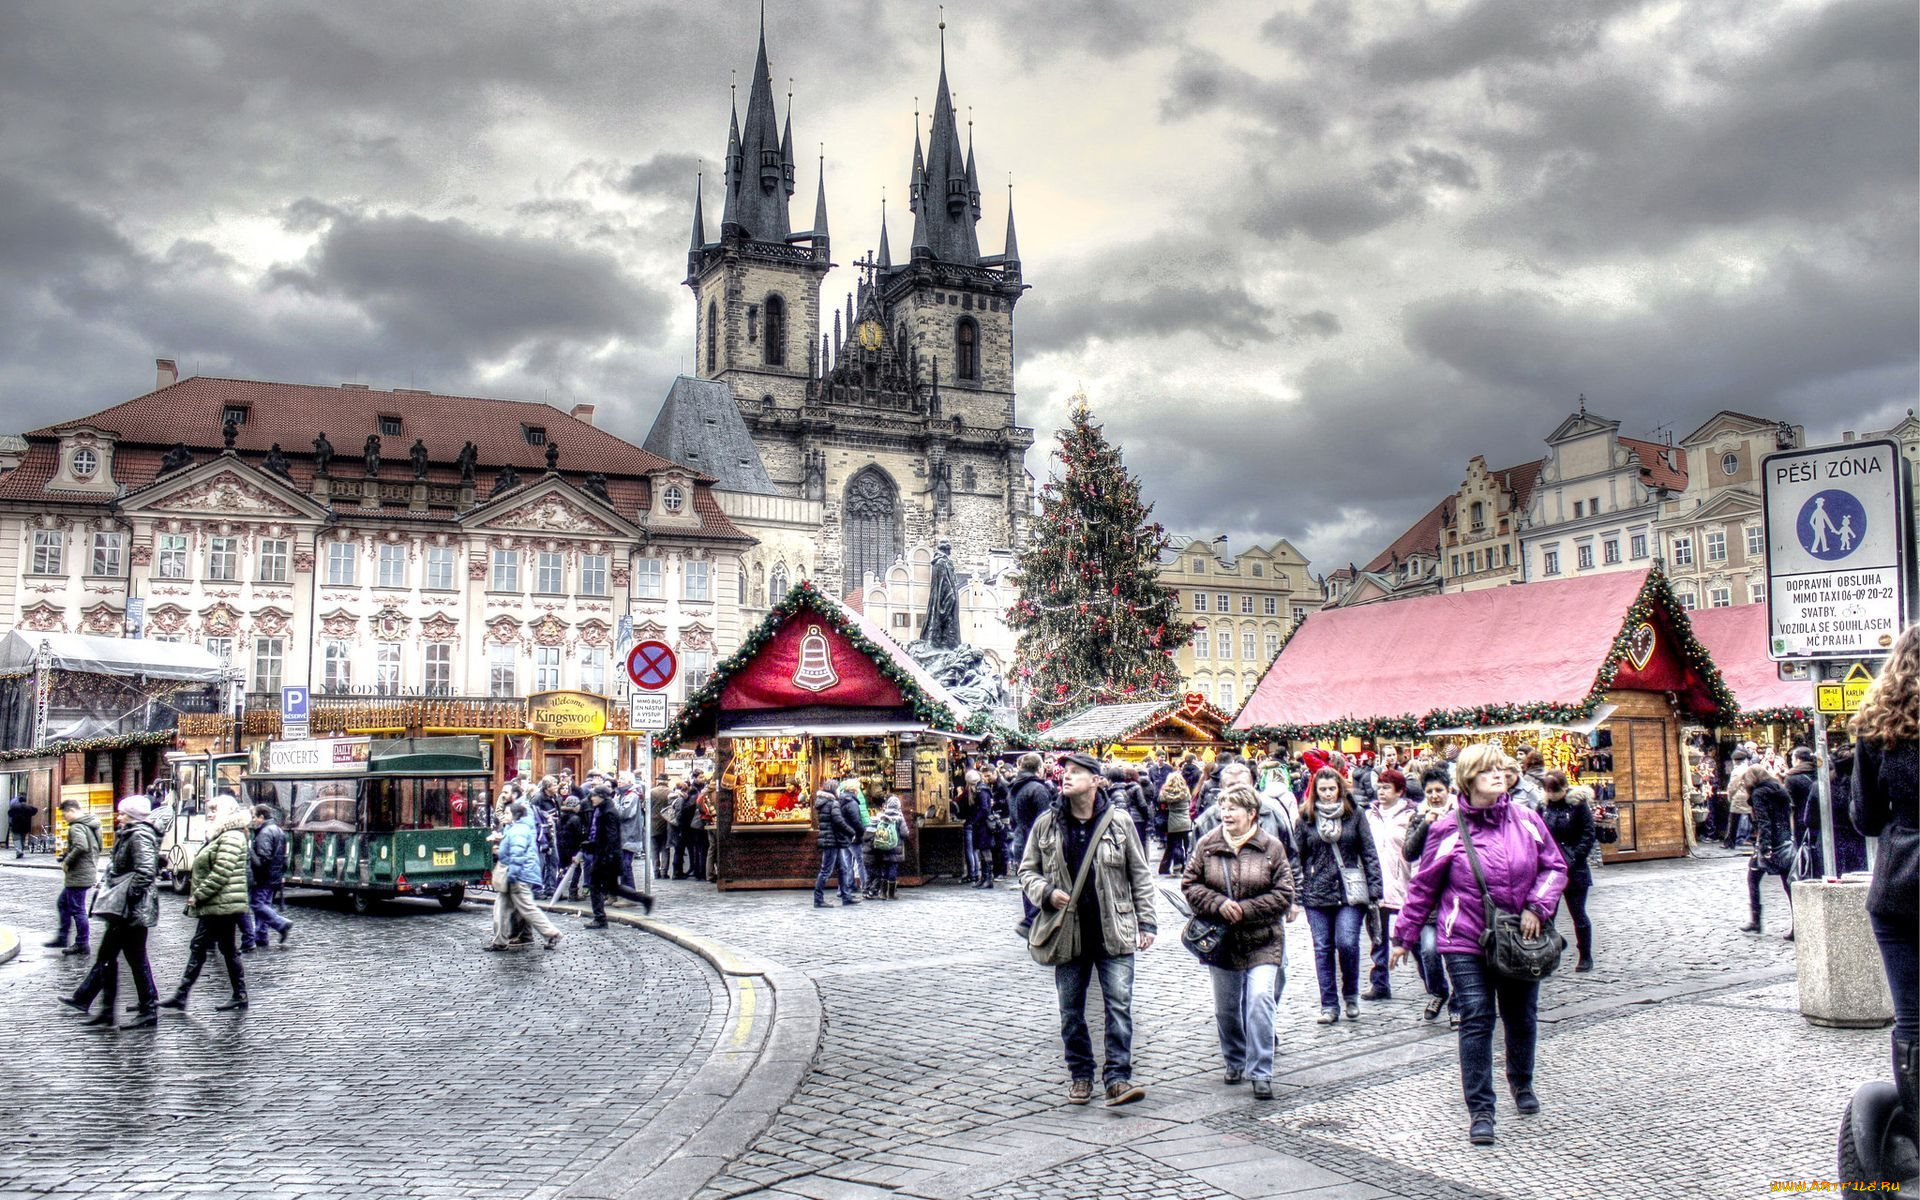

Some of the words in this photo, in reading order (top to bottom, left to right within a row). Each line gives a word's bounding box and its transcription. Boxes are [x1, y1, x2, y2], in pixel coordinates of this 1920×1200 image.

[1777, 460, 1817, 484] PĚŠÍ
[1828, 456, 1882, 478] ZÓNA
[1786, 575, 1832, 591] DOPRAVNÍ
[1837, 574, 1882, 587] OBSLUHA
[1793, 592, 1817, 604] MIMO
[1819, 590, 1840, 602] TAXI
[1841, 589, 1866, 601] 06-09
[1867, 587, 1893, 599] 20-22
[1780, 622, 1816, 634] VOZIDLA
[1818, 621, 1830, 633] SE
[1833, 618, 1892, 632] SOUHLASEM
[1806, 634, 1820, 647] MČ
[1822, 634, 1855, 646] PRAHA
[1858, 634, 1862, 645] 1
[287, 691, 303, 712] P
[550, 696, 585, 709] Welcome
[535, 709, 598, 727] Kingswood
[271, 750, 319, 765] CONCERTS
[334, 744, 352, 756] DAILY
